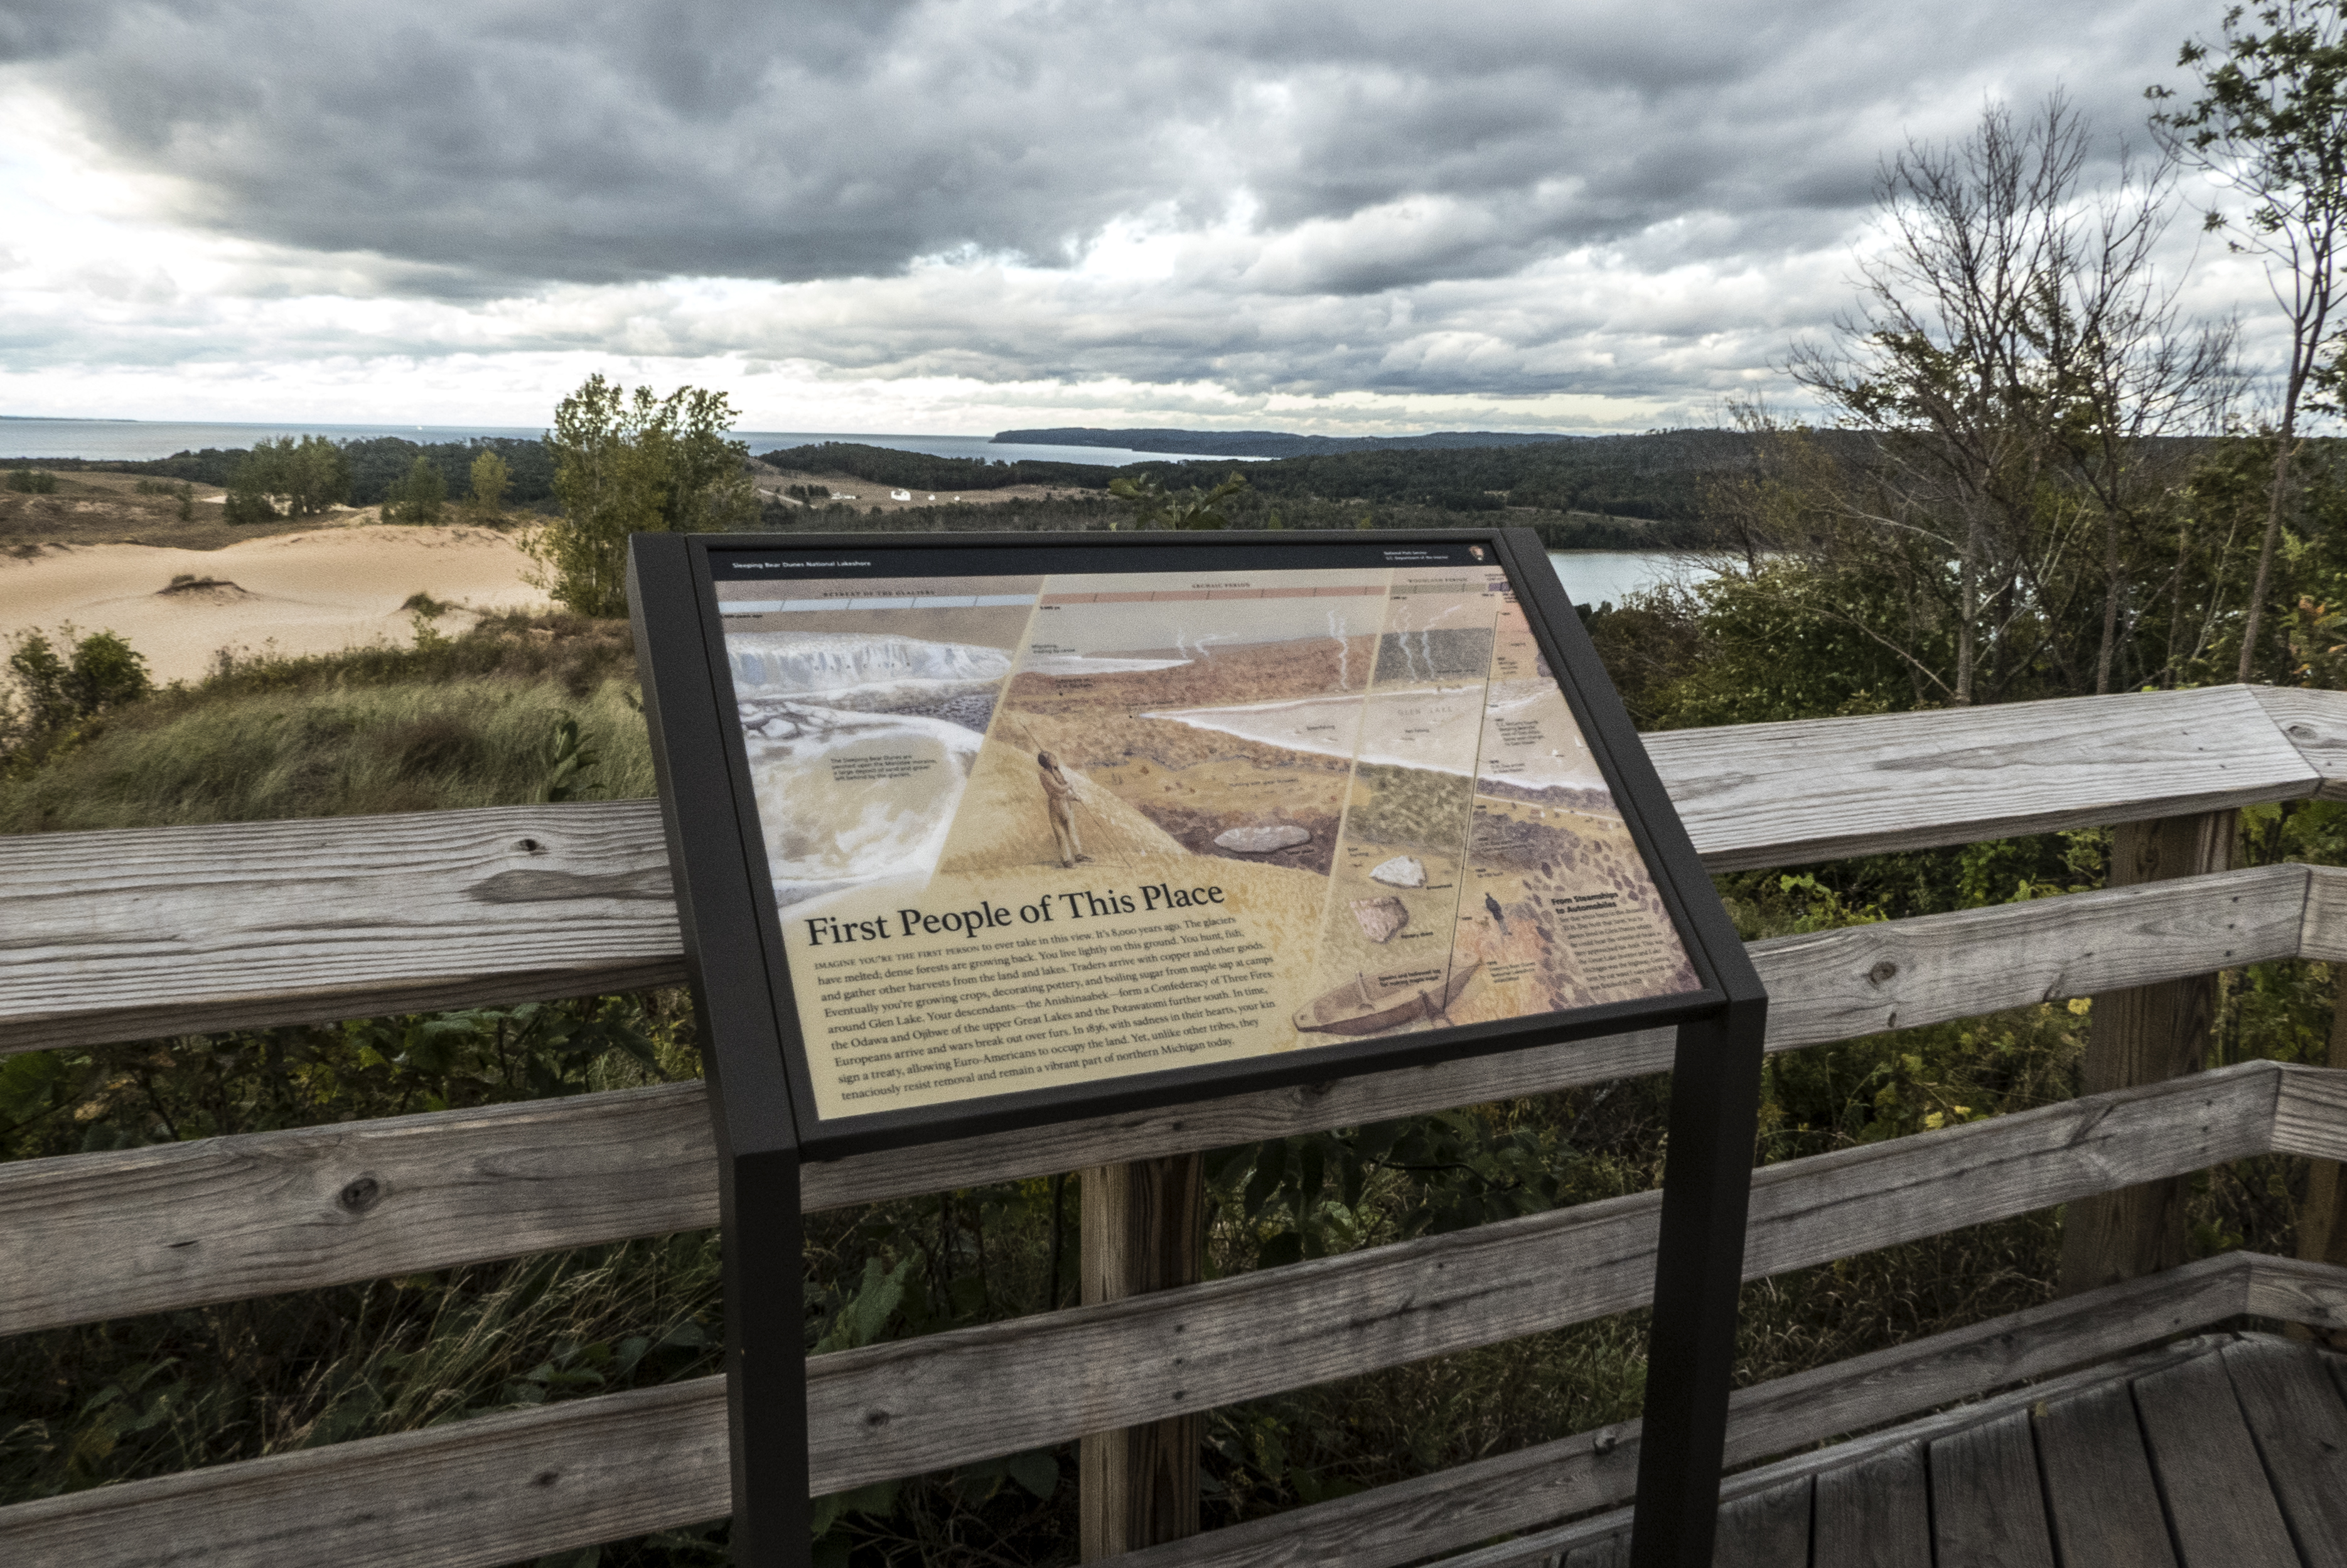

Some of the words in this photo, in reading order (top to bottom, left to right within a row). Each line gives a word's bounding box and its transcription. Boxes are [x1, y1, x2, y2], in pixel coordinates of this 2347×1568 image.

[804, 916, 891, 946] First
[898, 901, 1012, 938] People
[1020, 894, 1053, 923] of
[1058, 889, 1136, 918] This
[1139, 883, 1225, 910] Place
[1567, 901, 1617, 913] Automobiles
[1573, 893, 1618, 903] Steamships
[814, 959, 855, 970] IMAGINE
[918, 950, 942, 958] FIRST
[945, 946, 979, 955] PERSON
[1016, 938, 1036, 947] take
[1095, 930, 1110, 938] It's
[1138, 926, 1162, 934] years
[1164, 924, 1181, 932] ago.
[1183, 920, 1201, 928] The
[1203, 917, 1236, 927] glaciers
[818, 977, 841, 985] have
[884, 969, 913, 977] dense
[916, 965, 949, 974] forests
[969, 958, 1011, 970] growing
[1011, 953, 1034, 963] back.
[1078, 946, 1107, 957] lightly
[1144, 937, 1178, 949] ground.
[1225, 930, 1244, 938] fish,
[821, 992, 841, 1001] and
[844, 989, 876, 1001] gather
[879, 985, 905, 994] other
[908, 980, 951, 991] harvests
[953, 977, 977, 985] from
[997, 970, 1019, 980] land
[1022, 968, 1039, 977] and
[1041, 967, 1068, 975] lakes.
[1070, 962, 1107, 971] Traders
[1137, 955, 1158, 963] with
[1160, 952, 1190, 962] copper
[1193, 948, 1210, 957] and
[1237, 942, 1265, 953] goods.
[824, 1004, 878, 1018] Eventually
[915, 996, 958, 1008] growing
[960, 992, 990, 1001] crops,
[992, 985, 1045, 997] decorating
[1046, 981, 1083, 992] pottery,
[1085, 976, 1103, 985] and
[1104, 974, 1138, 982] boiling
[1139, 970, 1163, 979] sugar
[1190, 963, 1216, 973] maple
[1219, 962, 1233, 970] sap
[1245, 957, 1274, 965] camps
[828, 1021, 866, 1034] around
[868, 1019, 894, 1028] Glen
[896, 1015, 921, 1025] Lake.
[927, 1012, 952, 1021] Your
[1151, 980, 1208, 992] Confederacy
[831, 1041, 848, 1050] the
[851, 1038, 888, 1047] Odawa
[891, 1033, 910, 1043] and
[913, 1029, 948, 1039] Ojibwe
[951, 1025, 961, 1034] of
[964, 1024, 979, 1033] the
[983, 1021, 1011, 1031] upper
[1014, 1017, 1041, 1026] Great
[1044, 1012, 1073, 1022] Lakes
[1075, 1009, 1093, 1018] and
[1112, 1001, 1167, 1013] Potawatomi
[1169, 996, 1201, 1006] further
[1204, 991, 1229, 1001] south.
[834, 1054, 892, 1066] Europeans
[894, 1049, 924, 1058] arrive
[927, 1044, 947, 1054] and
[975, 1037, 1004, 1047] break
[1006, 1035, 1023, 1043] out
[1048, 1029, 1070, 1038] furs.
[1086, 1024, 1107, 1033] 1836,
[1109, 1020, 1131, 1029] with
[1133, 1016, 1169, 1026] sadness
[1182, 1011, 1203, 1019] their
[1205, 1007, 1237, 1016] hearts,
[1238, 1004, 1258, 1012] your
[838, 1075, 860, 1085] sign
[871, 1069, 905, 1079] treaty,
[907, 1062, 952, 1074] allowing
[953, 1051, 1036, 1067] Euro-Americans
[1051, 1044, 1085, 1053] occupy
[1088, 1040, 1103, 1048] the
[1105, 1036, 1129, 1046] land.
[1152, 1029, 1180, 1039] unlike
[1183, 1026, 1206, 1034] other
[1210, 1023, 1238, 1031] tribes,
[1239, 1019, 1259, 1028] they
[841, 1085, 900, 1100] tenaciously
[904, 1081, 931, 1092] resist
[933, 1073, 975, 1087] removal
[977, 1070, 997, 1081] and
[999, 1067, 1034, 1078] remain
[1045, 1060, 1080, 1071] vibrant
[1082, 1057, 1102, 1068] part
[1104, 1053, 1114, 1062] of
[1116, 1050, 1159, 1061] northern
[1161, 1043, 1205, 1054] Michigan
[1206, 1038, 1234, 1048] today.
